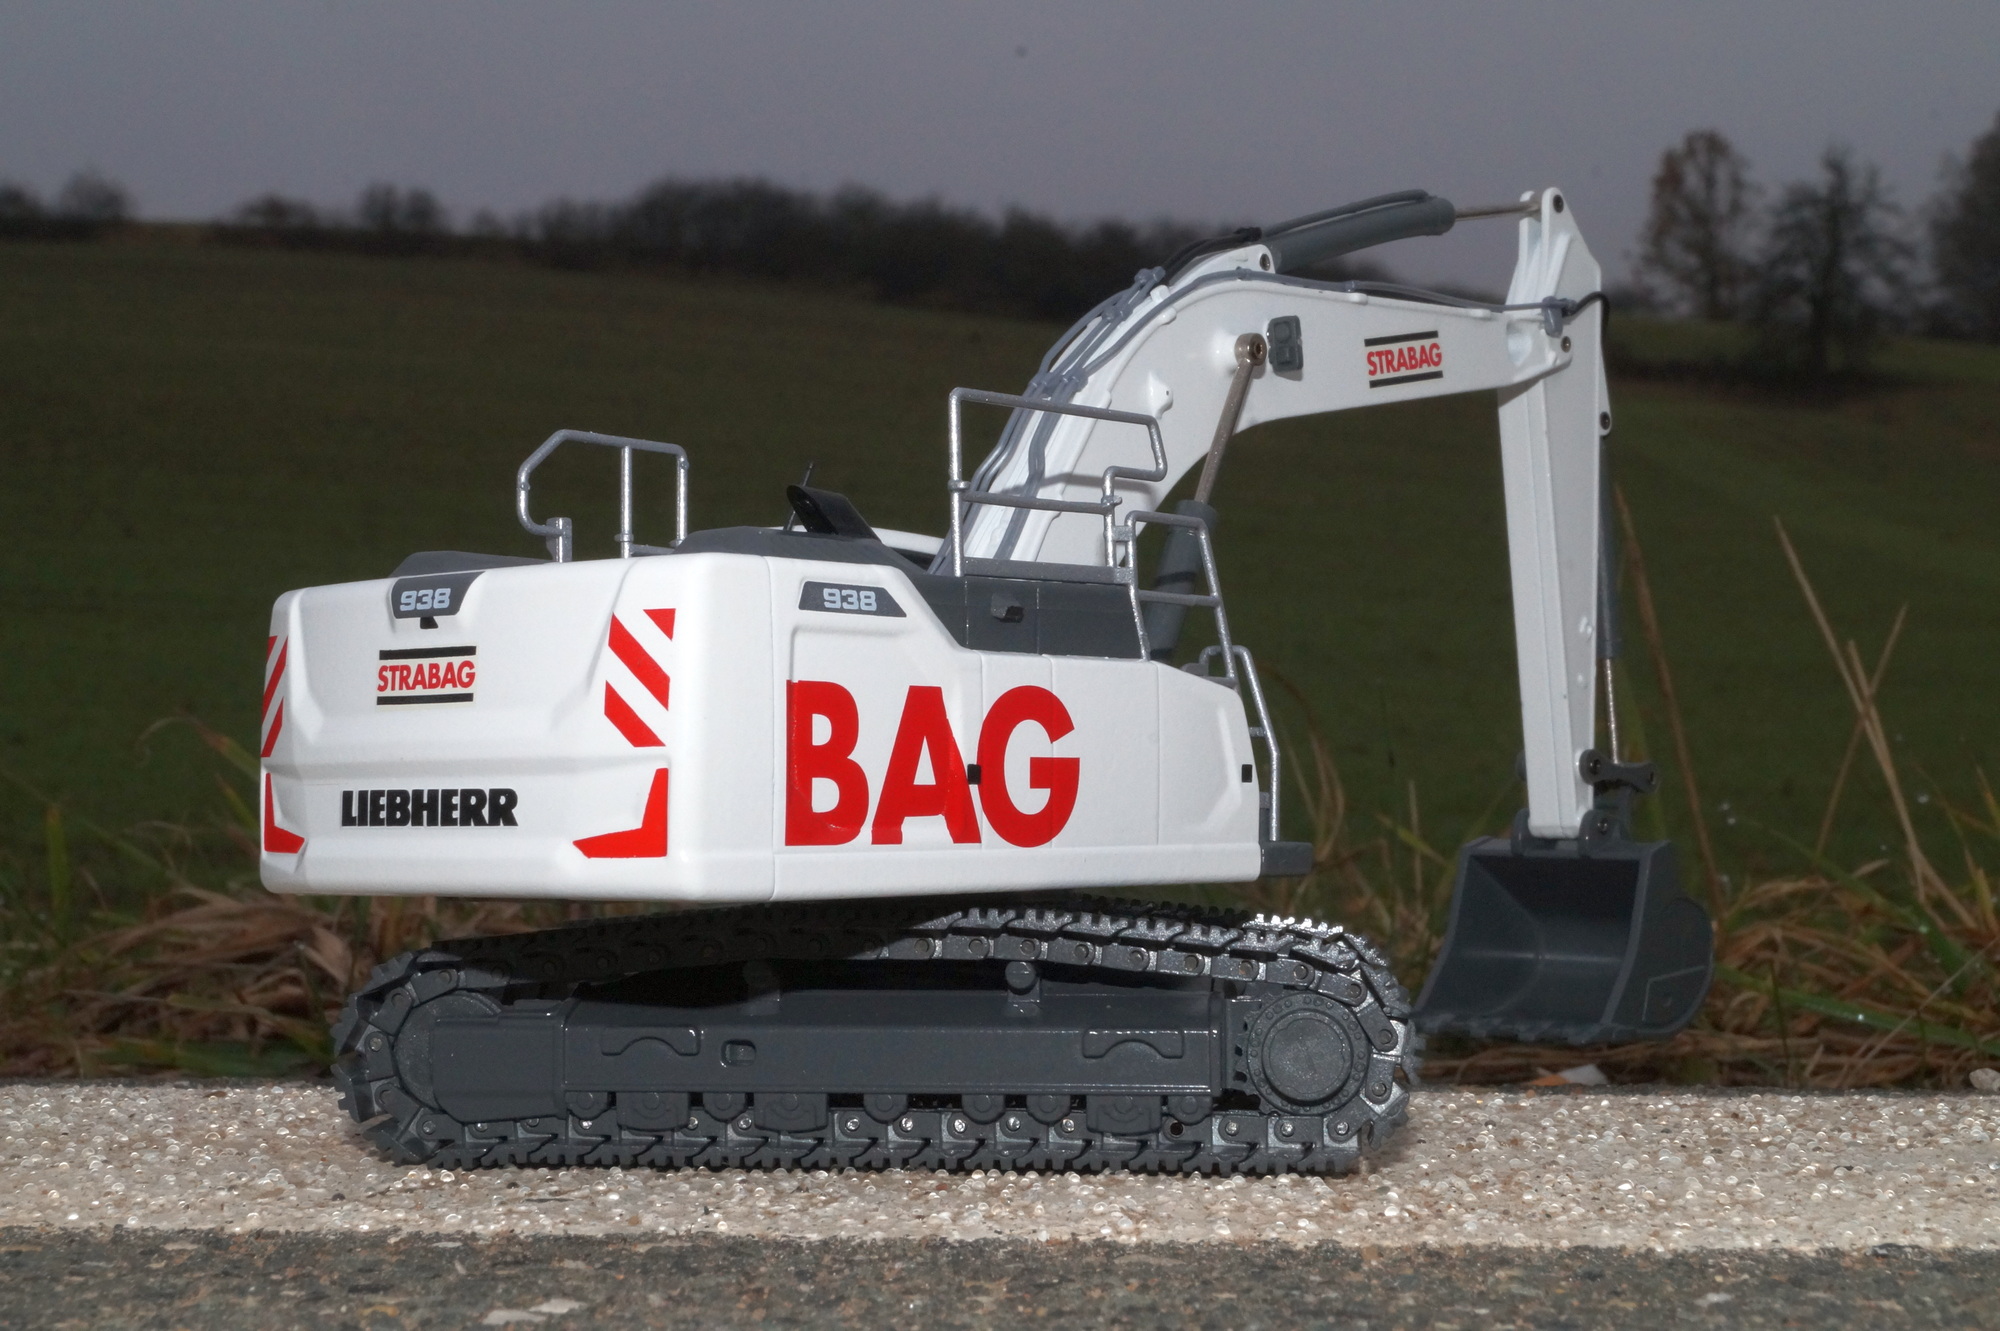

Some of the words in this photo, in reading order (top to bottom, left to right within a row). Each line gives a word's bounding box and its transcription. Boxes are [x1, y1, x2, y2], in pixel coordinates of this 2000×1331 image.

[1367, 342, 1442, 376] STRABAG
[400, 588, 451, 611] 938
[823, 588, 877, 612] 938
[377, 659, 476, 692] STRABAG
[785, 679, 1080, 848] BAG
[341, 788, 518, 827] LIEBHERR
